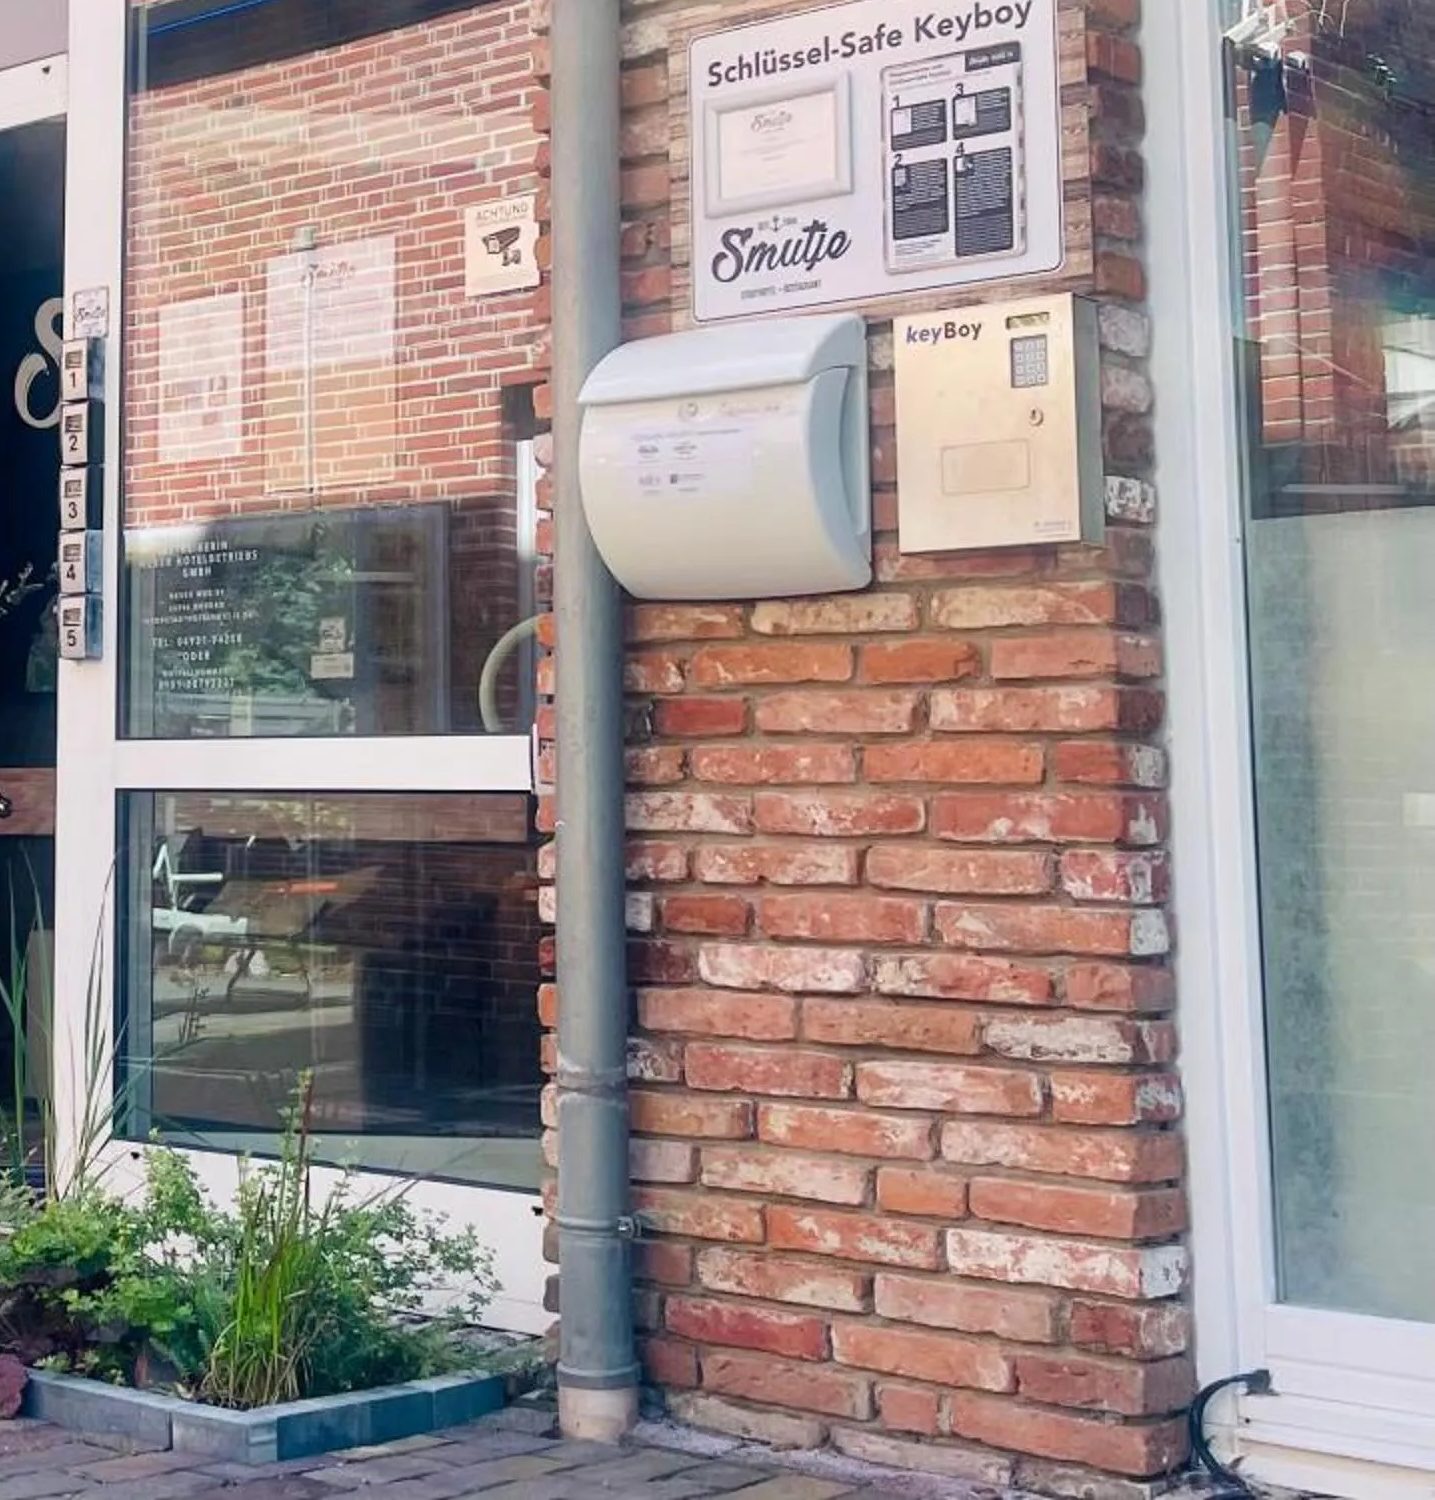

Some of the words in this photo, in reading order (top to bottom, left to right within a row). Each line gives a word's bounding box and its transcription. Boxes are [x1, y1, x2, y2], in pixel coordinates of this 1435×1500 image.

[708, 25, 903, 87] Schlüssel-Safe
[914, 0, 1033, 44] Keyboy
[955, 83, 964, 95] 3
[956, 142, 964, 156] 4
[711, 219, 852, 283] Smutje
[906, 322, 982, 344] keyBoy
[69, 372, 76, 388] 1
[69, 435, 78, 451] 2
[68, 501, 77, 519] 3
[67, 565, 76, 581] 4
[67, 630, 76, 647] 5
[182, 650, 210, 661] ODER
